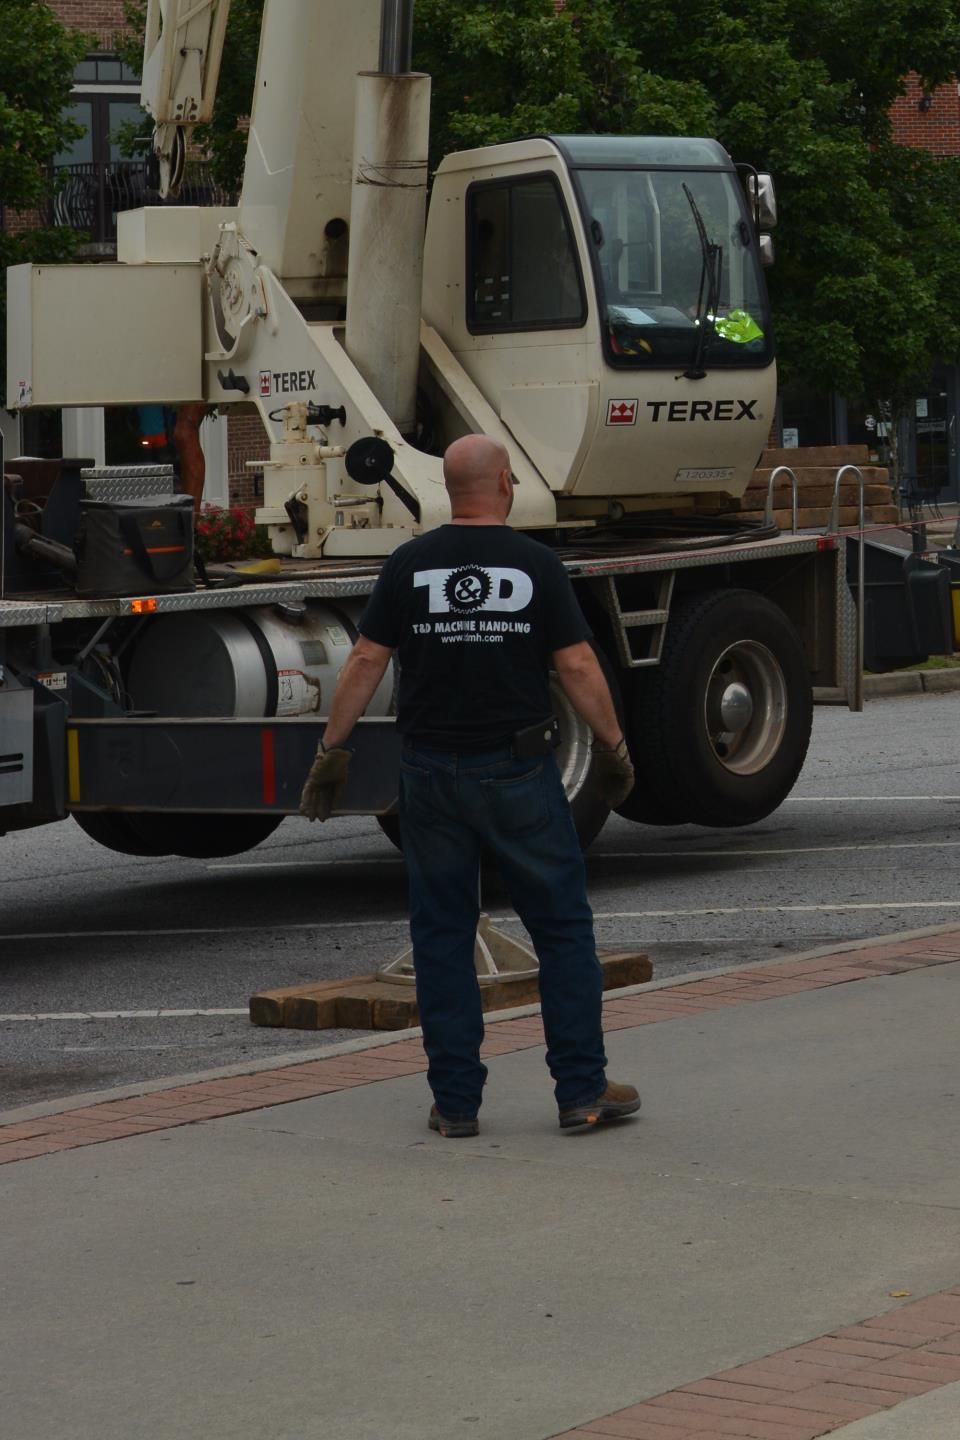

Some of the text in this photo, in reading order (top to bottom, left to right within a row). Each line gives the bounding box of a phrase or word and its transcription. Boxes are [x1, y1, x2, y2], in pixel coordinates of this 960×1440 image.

[273, 370, 316, 393] TEREX
[647, 400, 758, 422] TEREX
[413, 563, 534, 614] T&D
[412, 621, 531, 634] T&D MACHINE HANDLING
[441, 633, 504, 643] www.dmh.com
